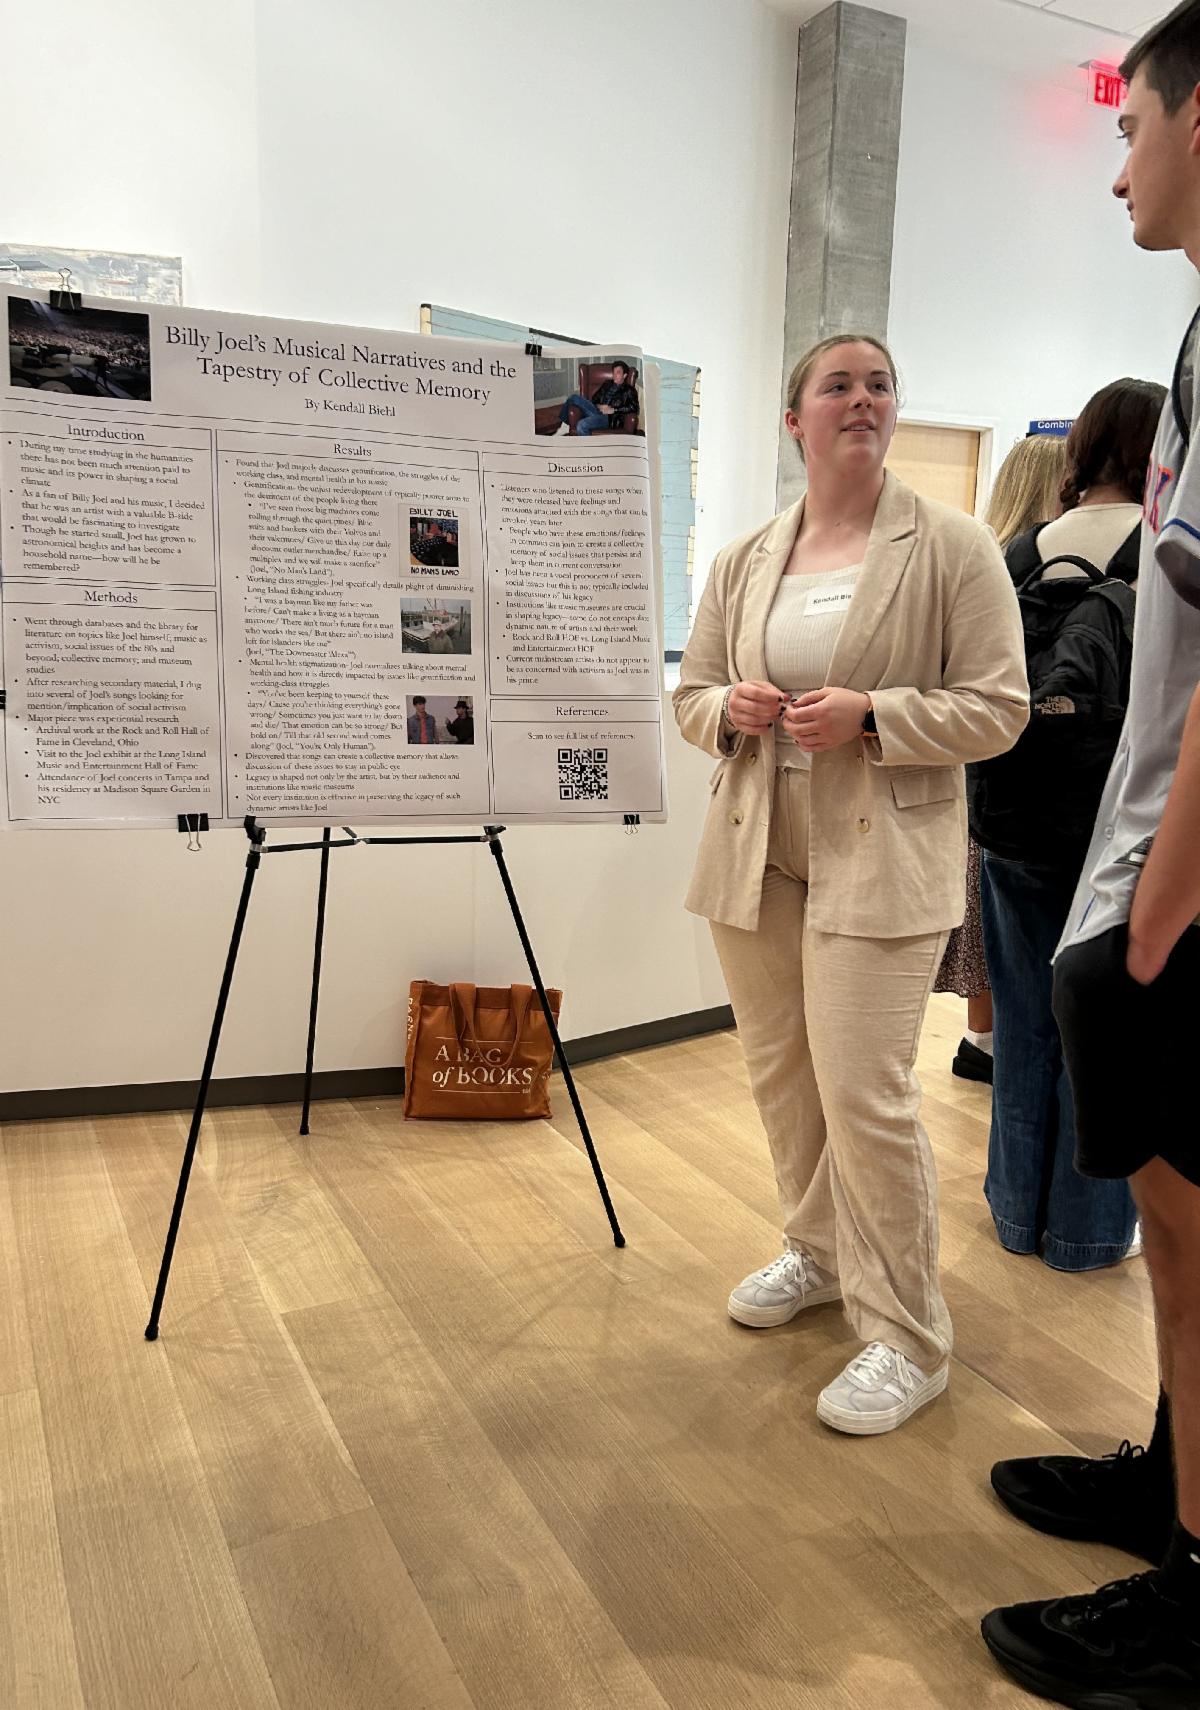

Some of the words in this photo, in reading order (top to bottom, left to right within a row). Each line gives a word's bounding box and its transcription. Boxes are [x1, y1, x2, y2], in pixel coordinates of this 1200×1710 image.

[1094, 72, 1126, 107] EXIT
[166, 326, 209, 352] Billy
[215, 331, 266, 355] Joel's
[273, 337, 345, 361] Musical
[352, 345, 446, 371] Narratives
[452, 356, 483, 375] and
[490, 359, 516, 378] the
[197, 357, 282, 387] Tapestry
[288, 367, 311, 384] of
[318, 369, 409, 394] Collective
[416, 378, 490, 405] Memory
[305, 399, 320, 412] By
[323, 401, 365, 414] Kendall
[369, 404, 396, 417] Biehl
[1038, 420, 1074, 429] Combin
[68, 425, 144, 440] Introduction
[334, 443, 372, 456] Results
[548, 463, 604, 473] Discussion
[410, 508, 432, 516] BILLY
[437, 509, 458, 518] JOEL
[84, 590, 138, 603] Methods
[556, 707, 609, 716] References
[434, 1044, 450, 1061] A
[456, 1048, 501, 1062] BAG
[432, 1066, 454, 1088] of
[457, 1067, 533, 1085] BOOKS
